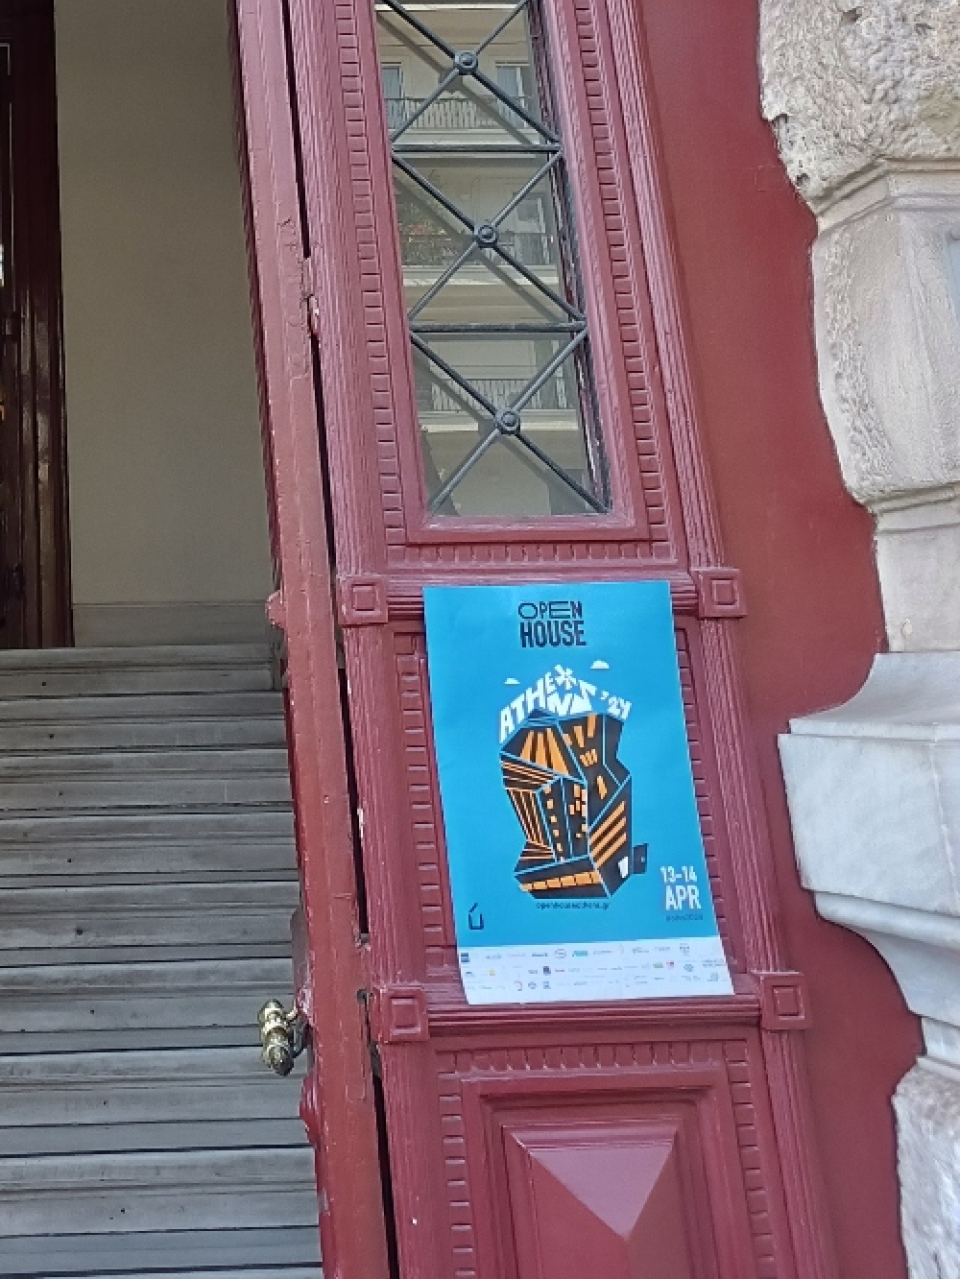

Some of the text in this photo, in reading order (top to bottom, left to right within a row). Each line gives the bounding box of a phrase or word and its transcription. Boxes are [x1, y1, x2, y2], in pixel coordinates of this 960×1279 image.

[518, 600, 583, 619] OPEN
[520, 620, 587, 648] HOUSE
[660, 865, 698, 883] 13-14
[665, 884, 702, 911] APR
